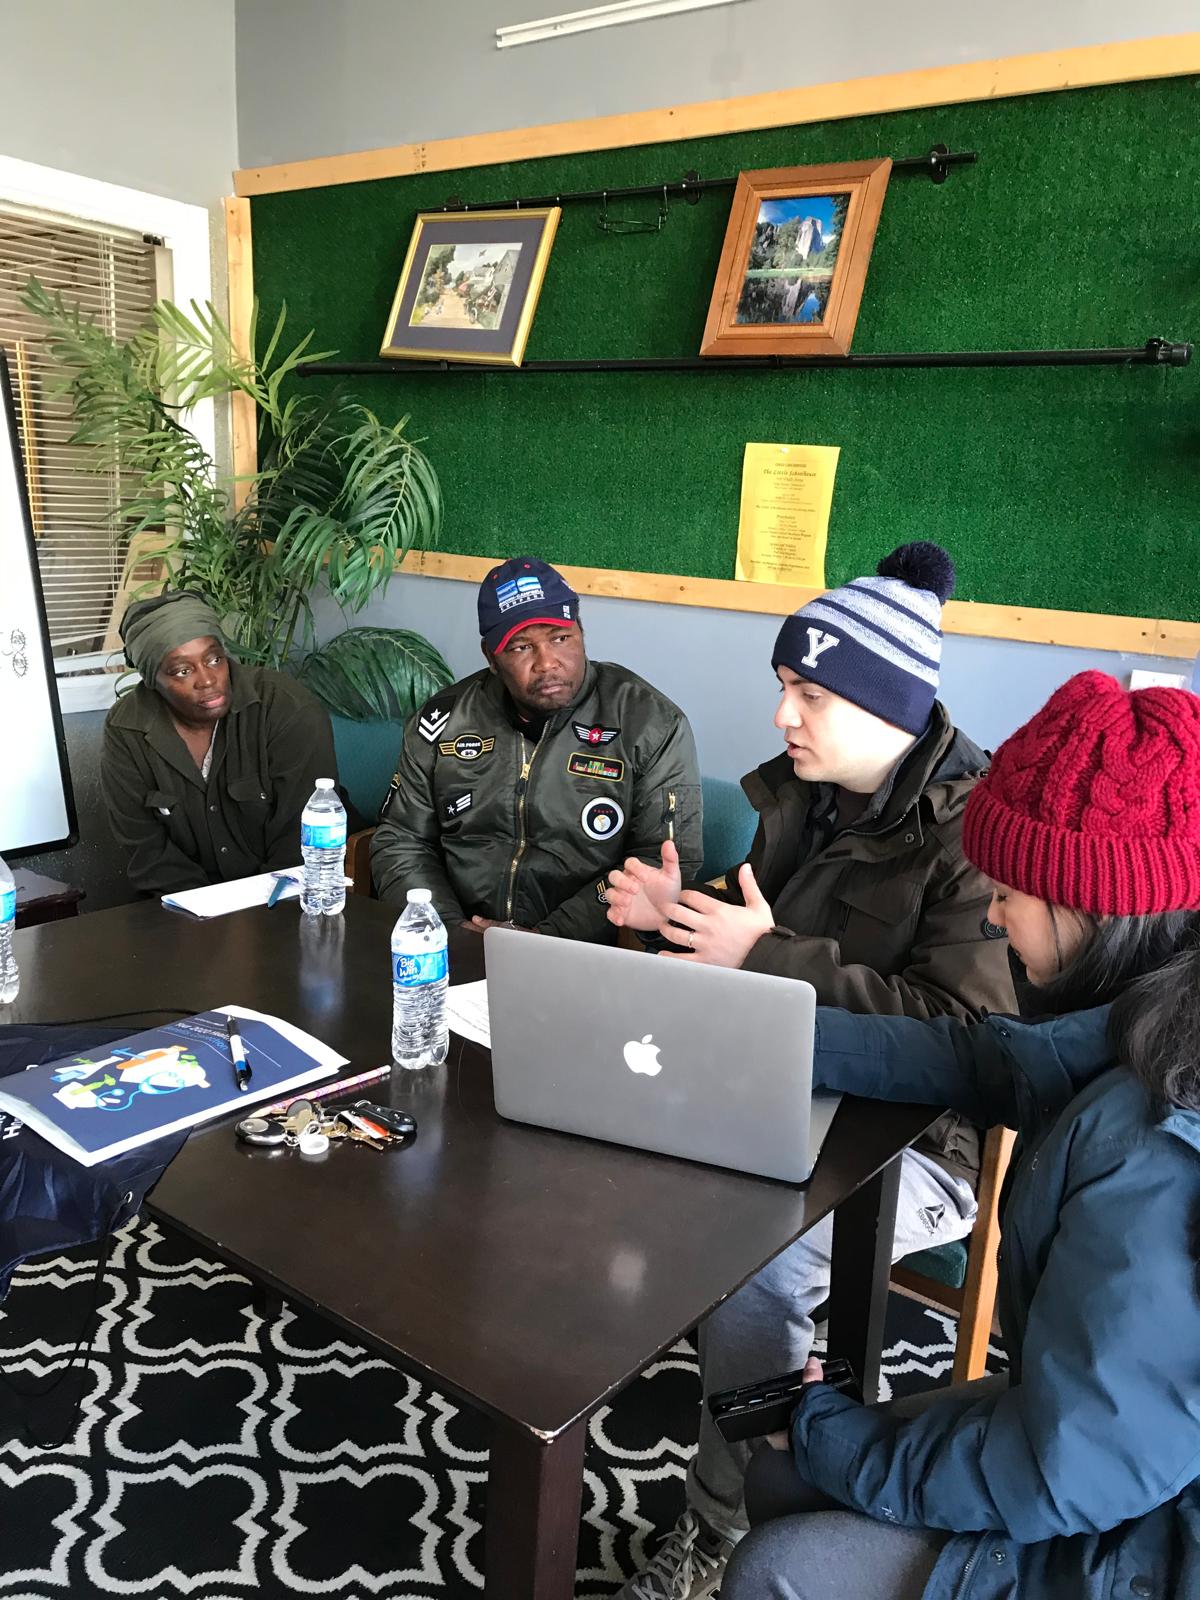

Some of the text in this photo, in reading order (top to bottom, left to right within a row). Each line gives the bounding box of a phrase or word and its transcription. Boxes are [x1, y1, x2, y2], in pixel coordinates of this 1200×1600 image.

[801, 626, 840, 669] Y
[400, 957, 415, 968] Big
[400, 966, 418, 977] Win
[916, 1207, 935, 1237] Reebok
